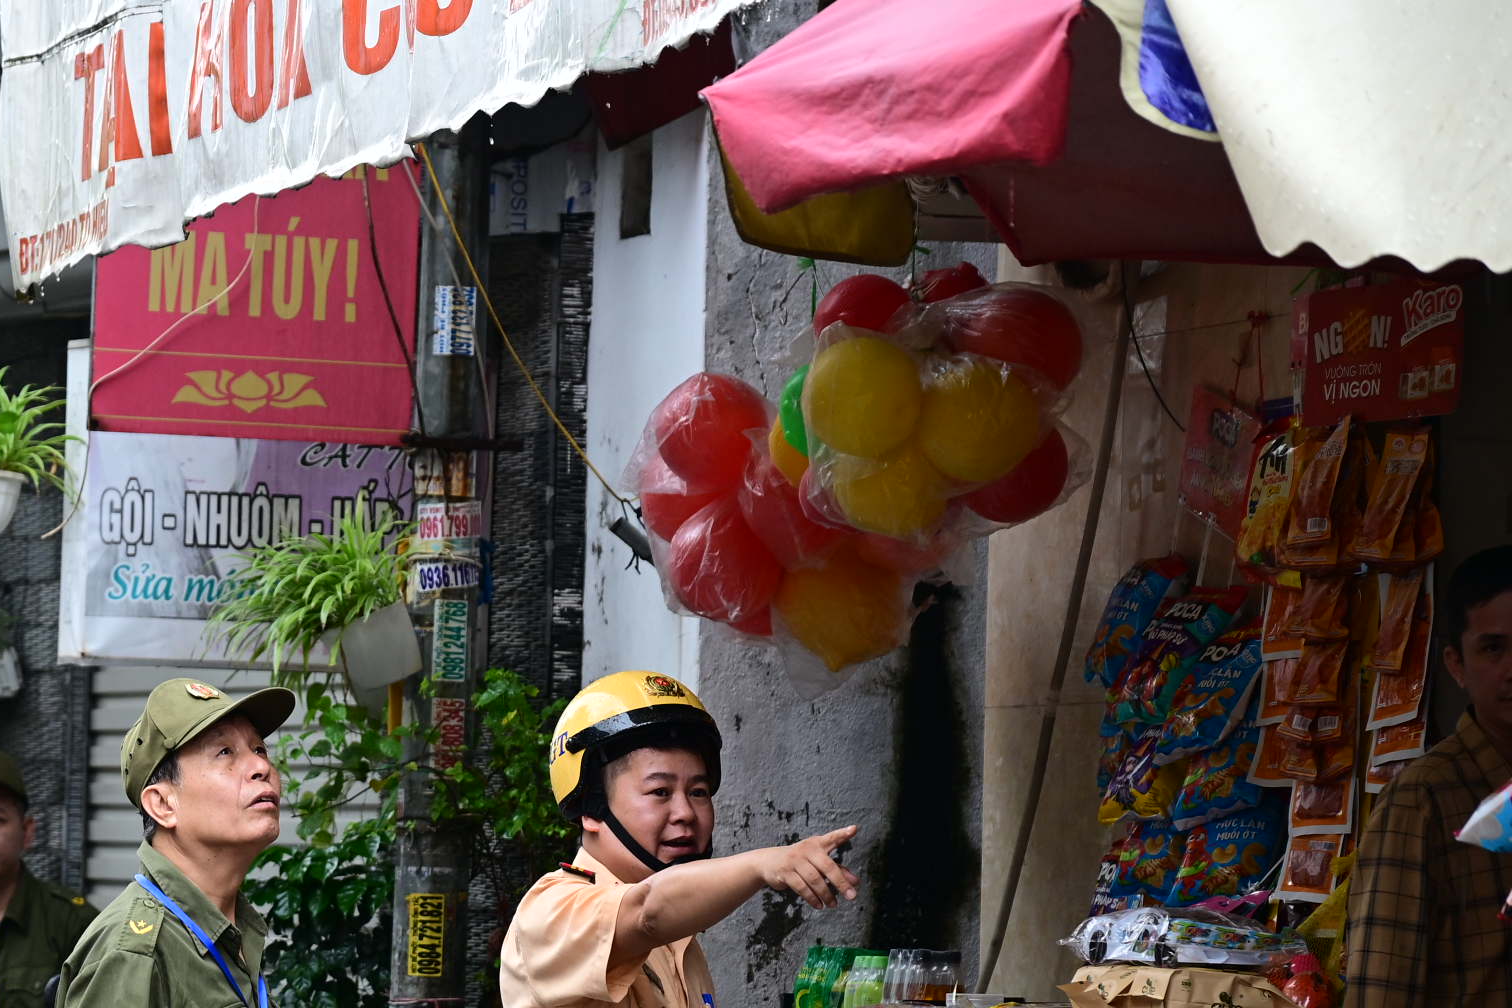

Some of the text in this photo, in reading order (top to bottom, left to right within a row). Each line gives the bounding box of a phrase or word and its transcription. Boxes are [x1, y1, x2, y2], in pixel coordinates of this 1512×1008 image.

[148, 230, 230, 317] MA
[245, 216, 359, 323] TÚY!
[1323, 379, 1381, 405] VỊ NGON
[99, 477, 155, 557] GỘI
[107, 562, 175, 601] Sửa
